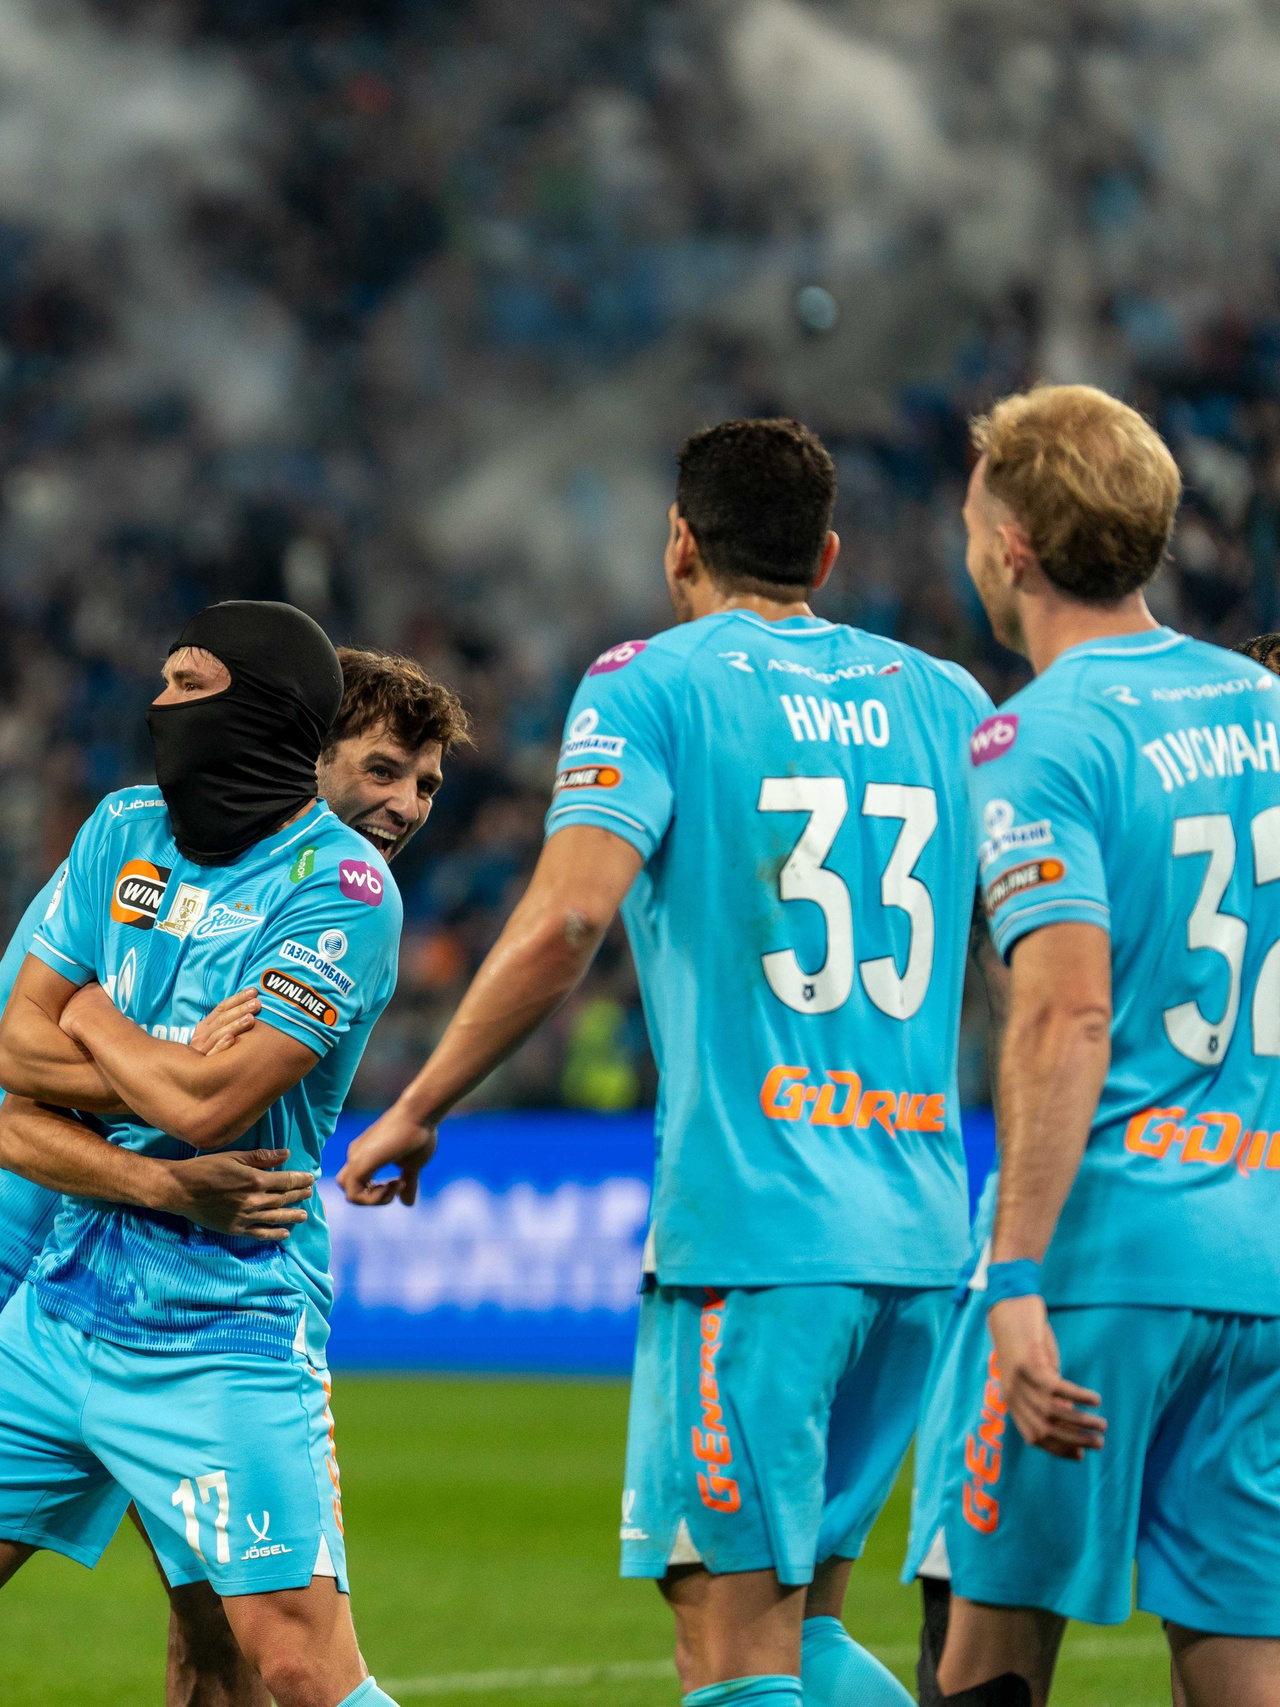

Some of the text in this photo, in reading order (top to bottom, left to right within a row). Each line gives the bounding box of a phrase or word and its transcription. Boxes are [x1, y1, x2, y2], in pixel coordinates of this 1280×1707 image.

[780, 694, 890, 748] НИНО
[342, 869, 382, 895] wb
[757, 776, 939, 1021] 33
[283, 943, 352, 994] ГАЗПРОМБАНК
[267, 974, 326, 1016] WINLINE
[172, 1470, 230, 1564] 17
[241, 1544, 292, 1560] JÖGEL
